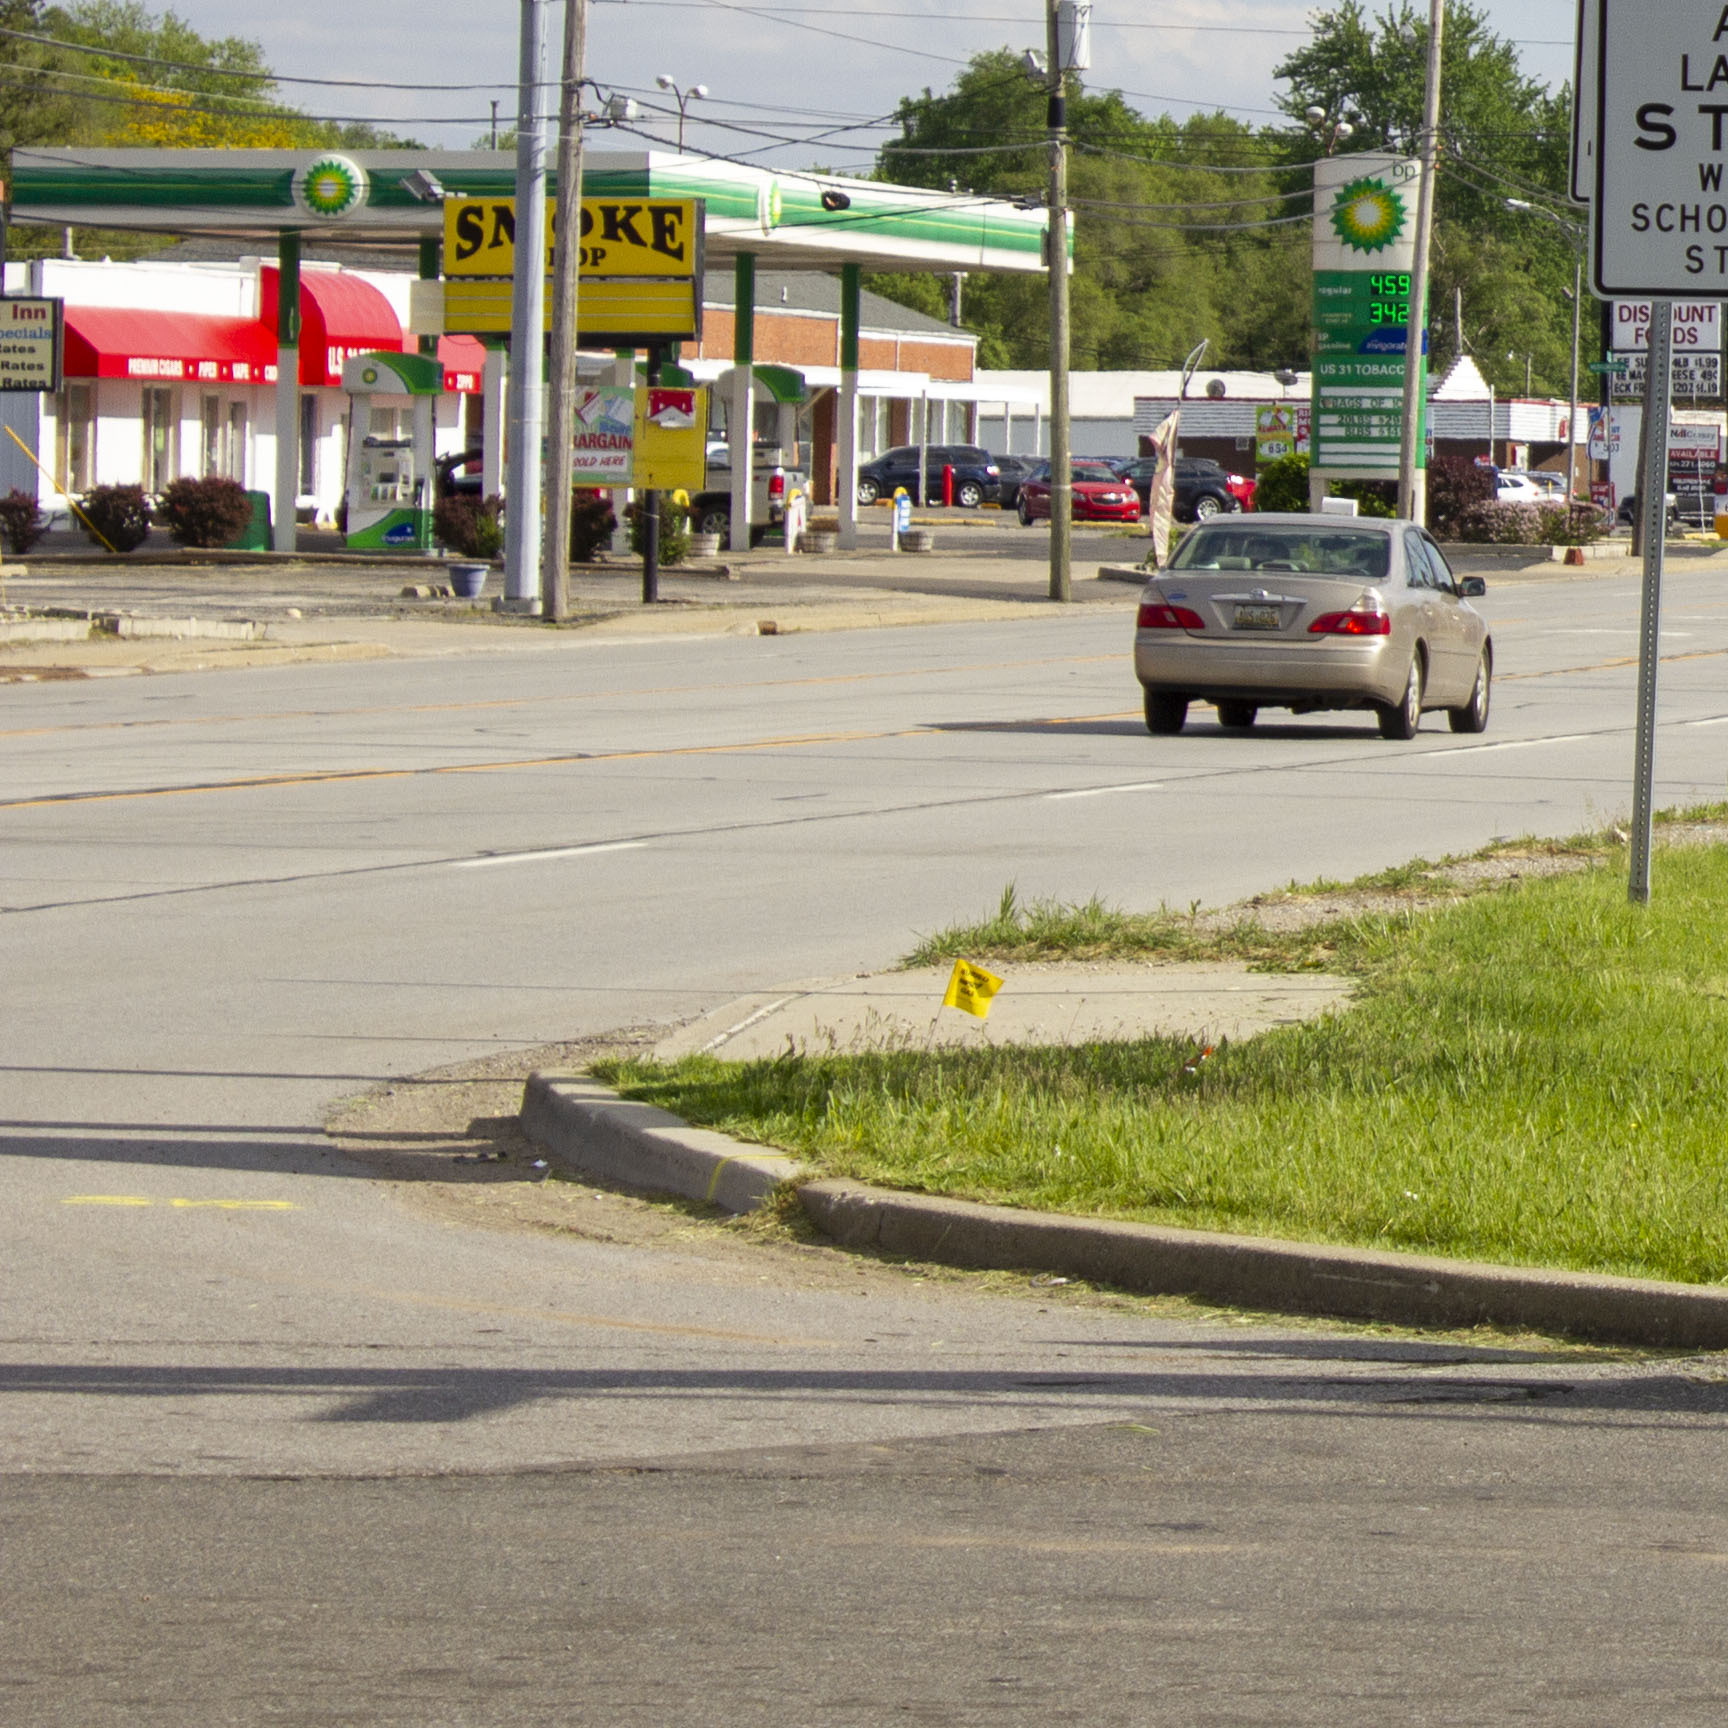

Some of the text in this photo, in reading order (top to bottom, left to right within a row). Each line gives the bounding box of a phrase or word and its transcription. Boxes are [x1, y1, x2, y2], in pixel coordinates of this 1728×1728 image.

[1392, 160, 1416, 181] bp
[1318, 275, 1411, 298] regular 459
[12, 303, 47, 320] Inn
[1370, 302, 1410, 324] 342
[1618, 304, 1717, 324] DISUNT
[0, 327, 52, 342] pecials
[1635, 326, 1699, 345] FDS
[1320, 364, 1406, 376] US 31 TOBACC
